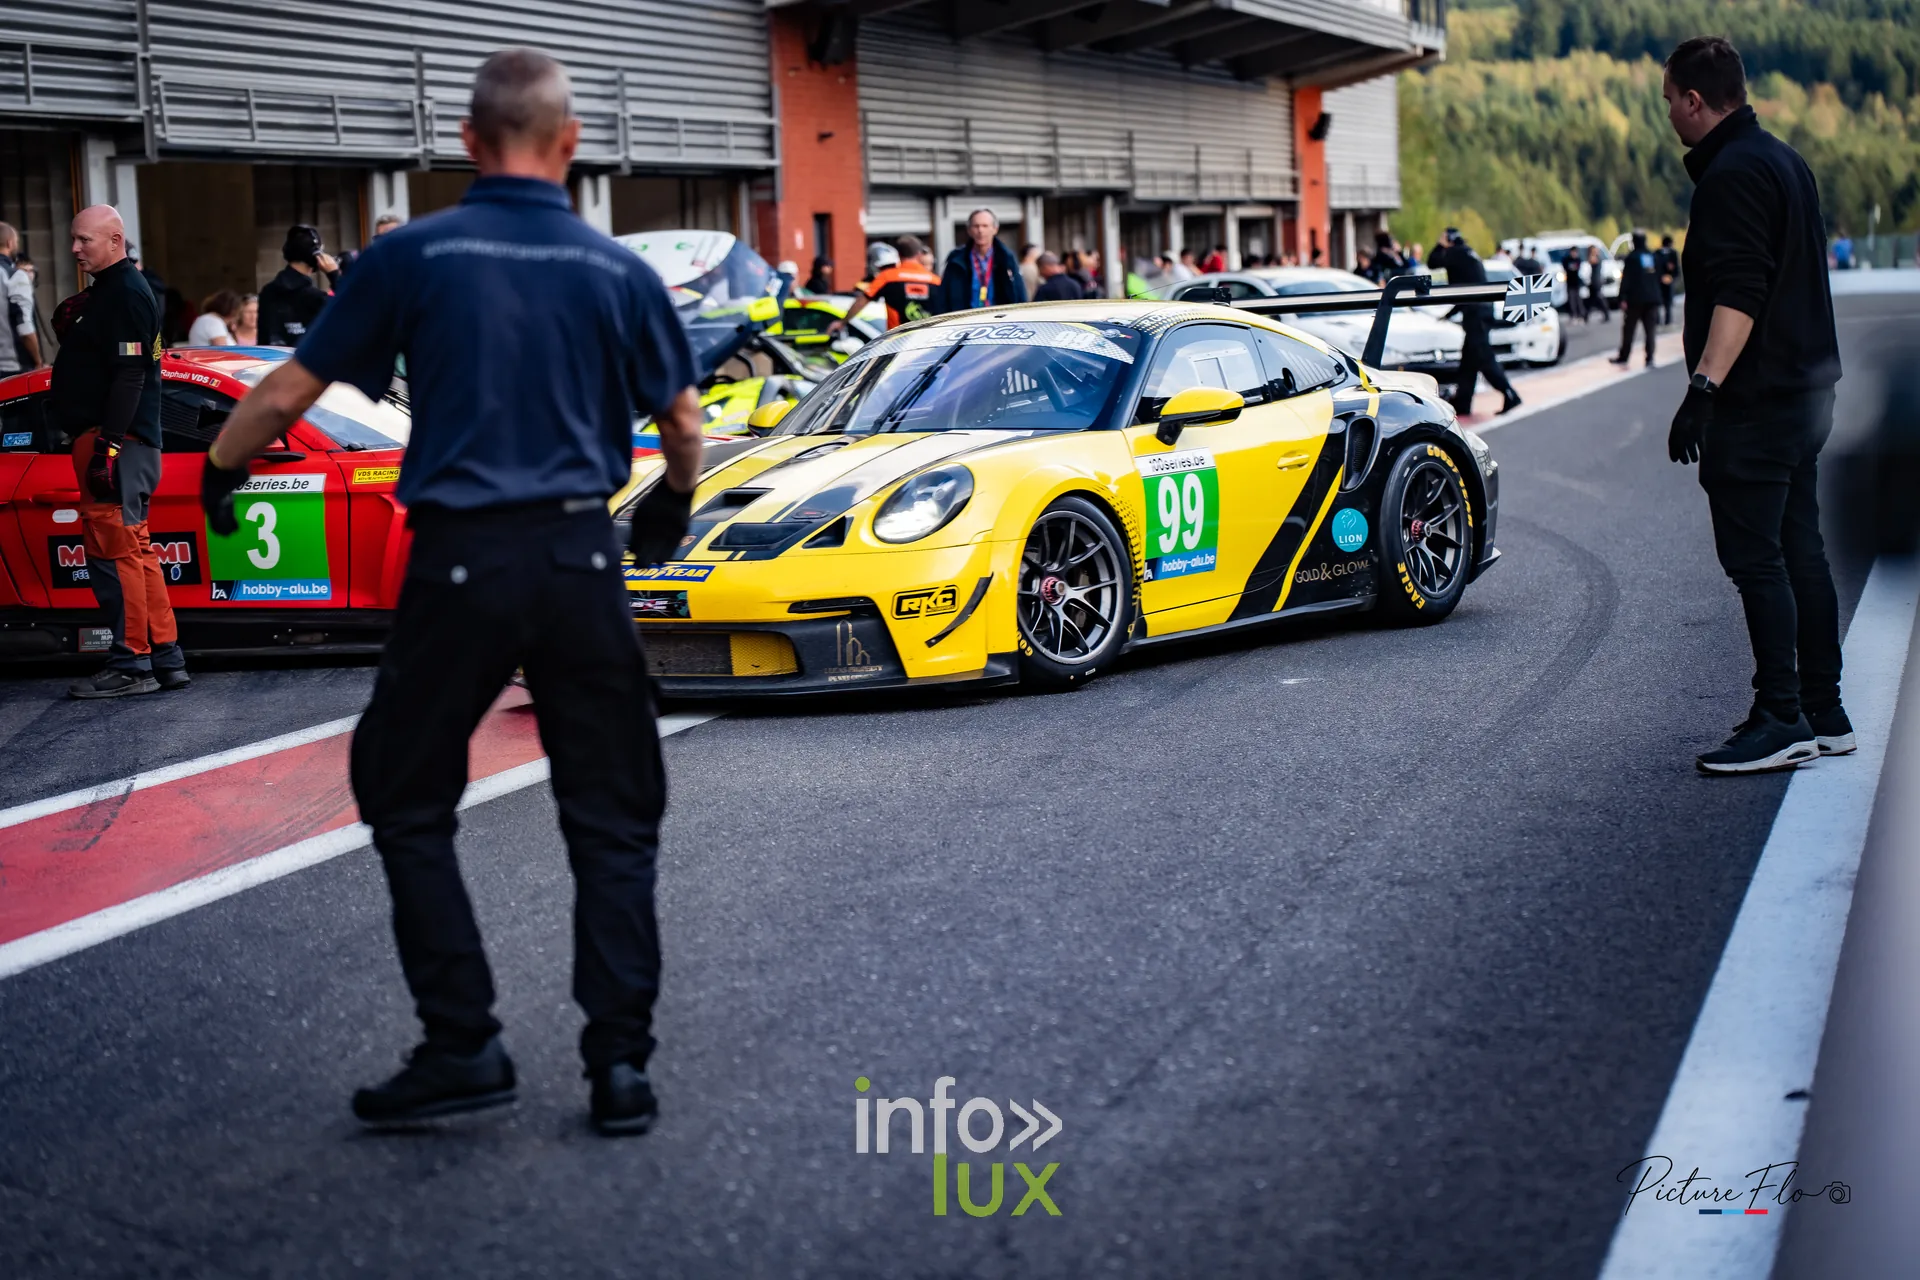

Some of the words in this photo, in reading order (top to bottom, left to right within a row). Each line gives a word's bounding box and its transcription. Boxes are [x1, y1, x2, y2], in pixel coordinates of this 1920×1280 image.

[190, 373, 210, 384] VDS
[372, 469, 399, 477] RACING
[236, 478, 310, 491] 0series.be
[1157, 473, 1205, 554] 99
[245, 501, 281, 570] 3
[1339, 534, 1363, 544] LION
[1161, 553, 1216, 573] hobby-alu.be
[1294, 568, 1320, 584] GOLD
[1332, 560, 1371, 576] GLOW
[242, 584, 328, 598] hobby-alu.be
[1397, 561, 1426, 609] EAGLE
[901, 588, 954, 613] RKC
